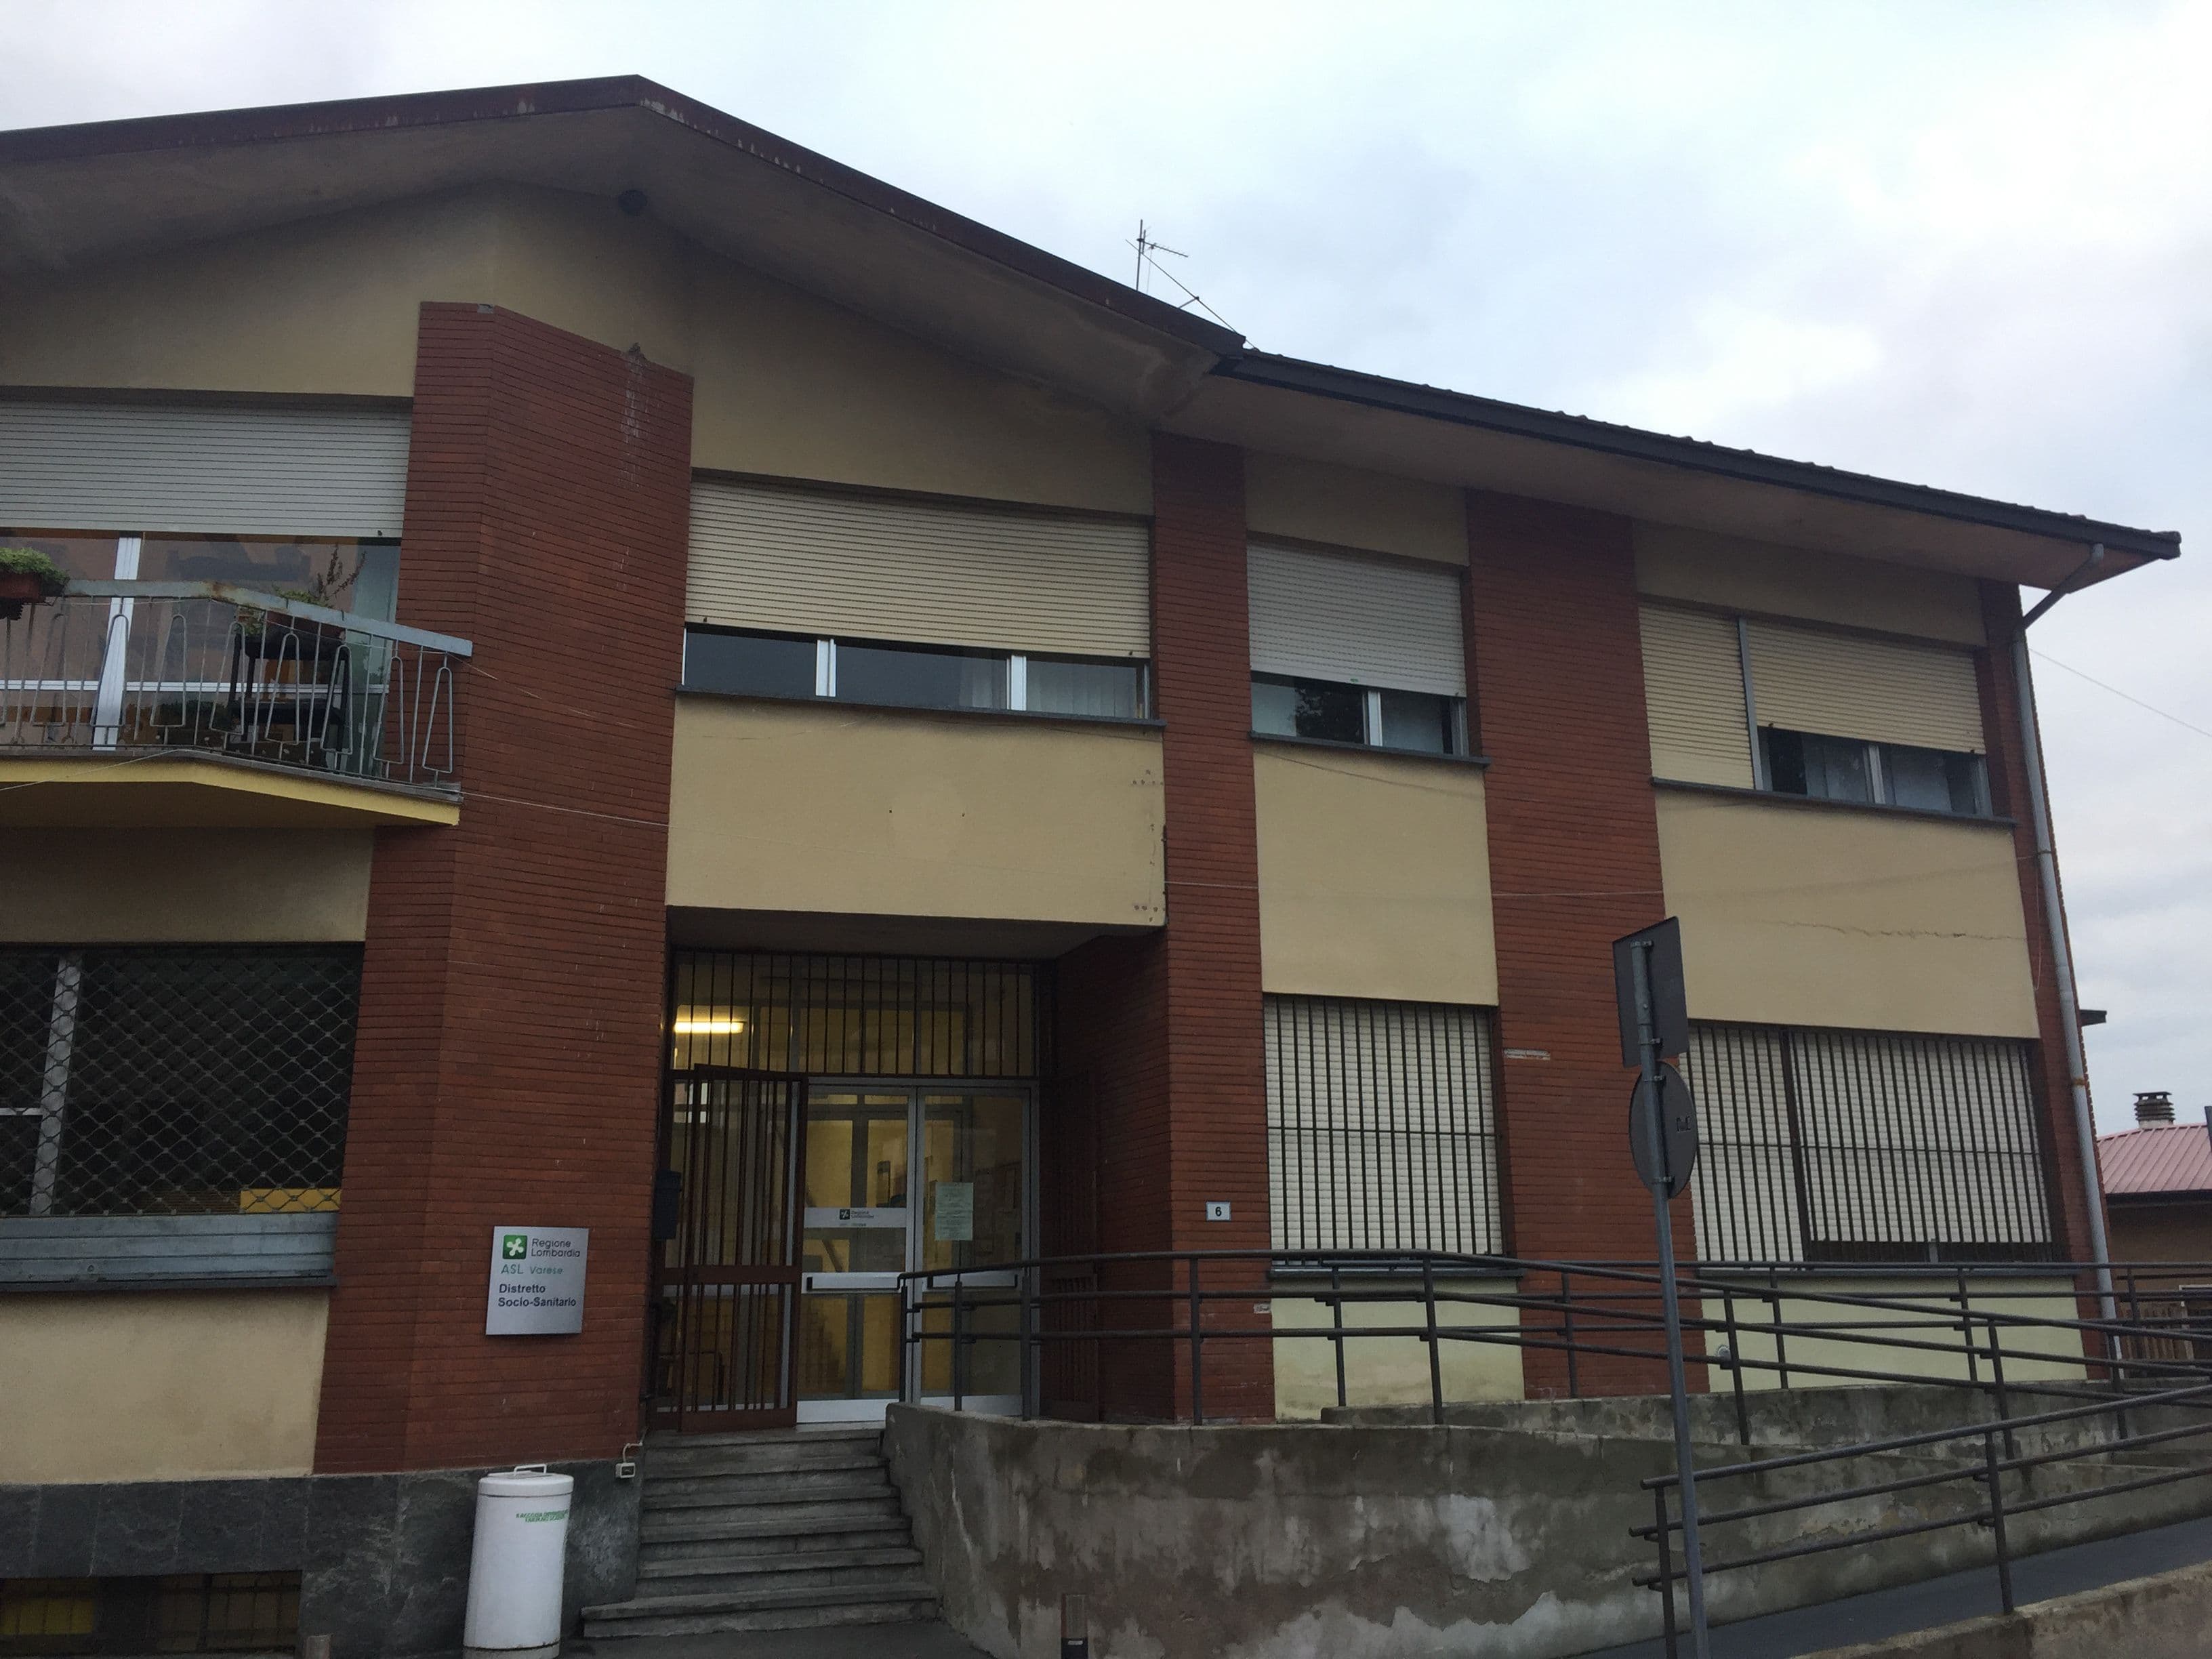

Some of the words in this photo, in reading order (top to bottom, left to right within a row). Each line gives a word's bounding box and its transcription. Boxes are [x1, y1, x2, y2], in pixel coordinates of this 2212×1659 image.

[1214, 1206, 1223, 1217] 6
[531, 1238, 571, 1249] Regione
[531, 1248, 581, 1258] Lombardia
[501, 1264, 524, 1274] ASL
[530, 1266, 563, 1275] Varese
[499, 1284, 546, 1294] Distretto
[498, 1296, 576, 1307] Socio-Sanitario
